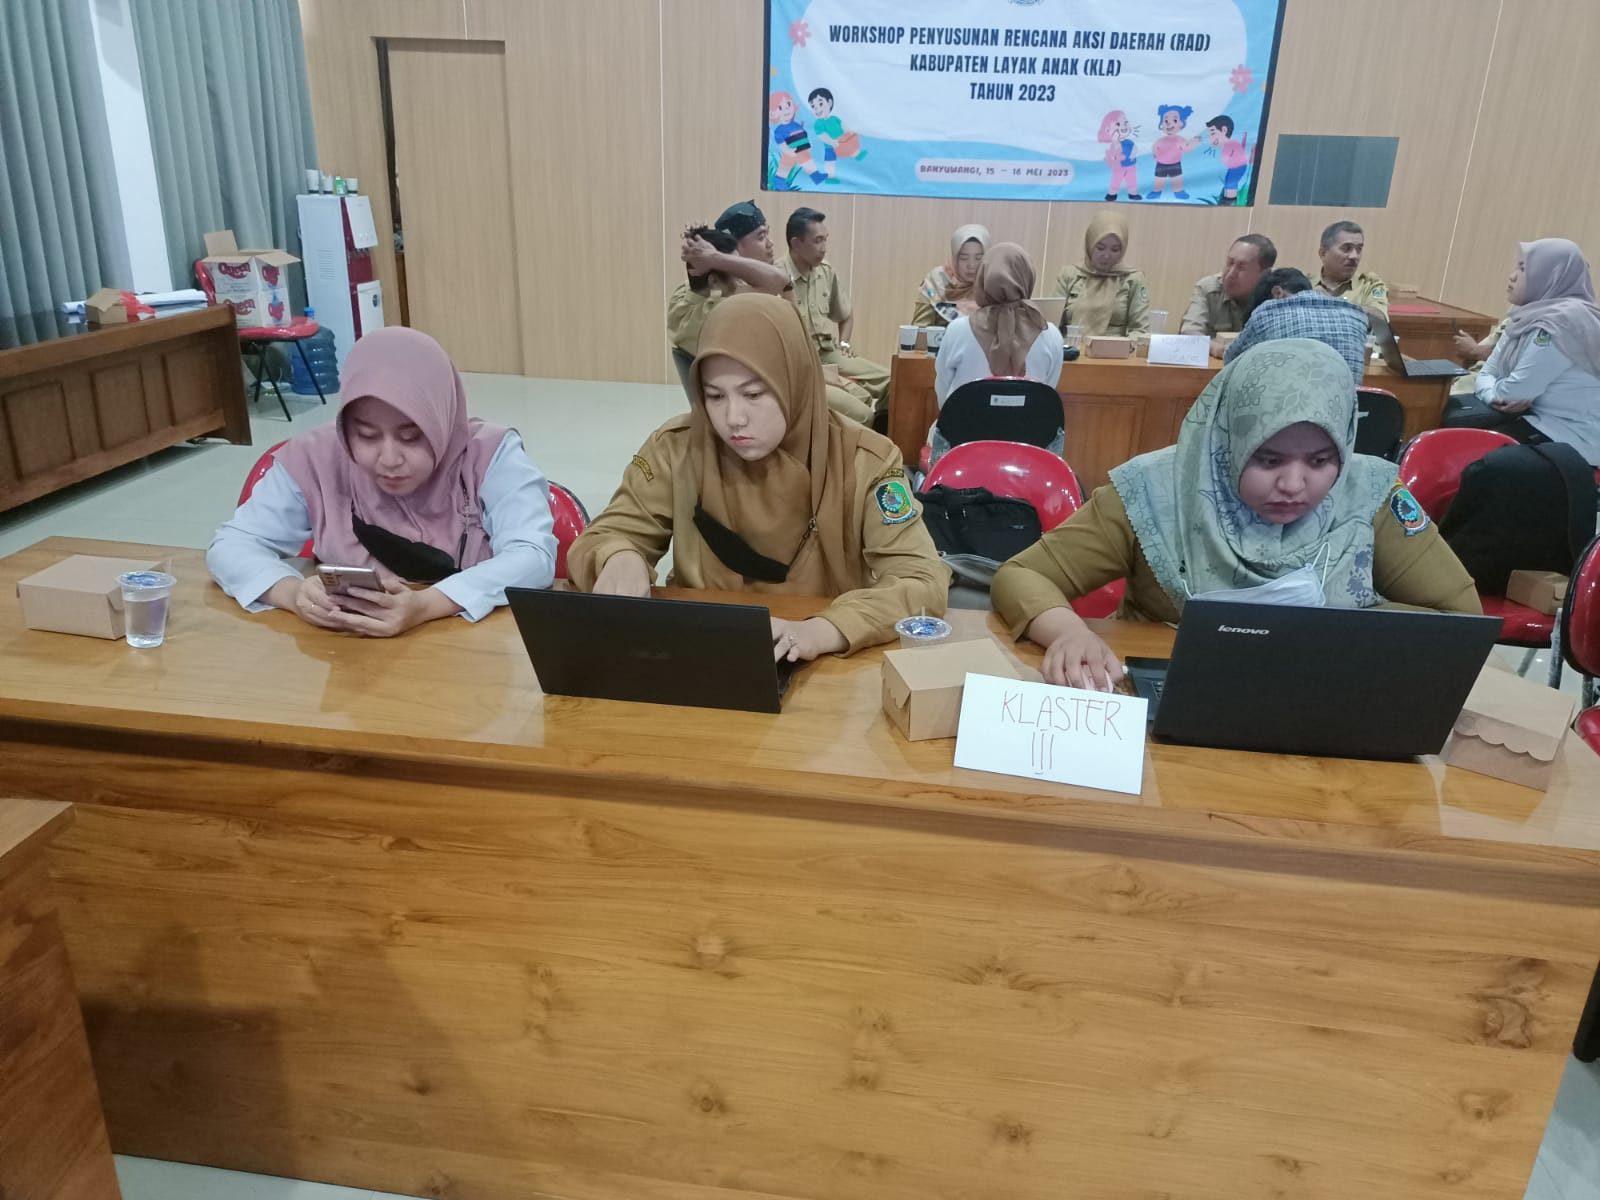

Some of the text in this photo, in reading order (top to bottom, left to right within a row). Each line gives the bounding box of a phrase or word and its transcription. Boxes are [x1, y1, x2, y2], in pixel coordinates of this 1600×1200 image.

[829, 25, 1211, 52] WORKSHOP PENYUSUNAN RENCANA AKSI DAERAH (RAD)
[910, 54, 1122, 77] KABUPATEN LAYAK ANAK (KLA)
[970, 82, 1056, 102] TAHUN 2023
[986, 167, 995, 175] 15
[1013, 168, 1021, 176] 16
[1026, 168, 1042, 177] MEI
[1047, 168, 1069, 177] 2023
[1217, 624, 1270, 635] lenovo
[1001, 690, 1122, 741] KLASTER
